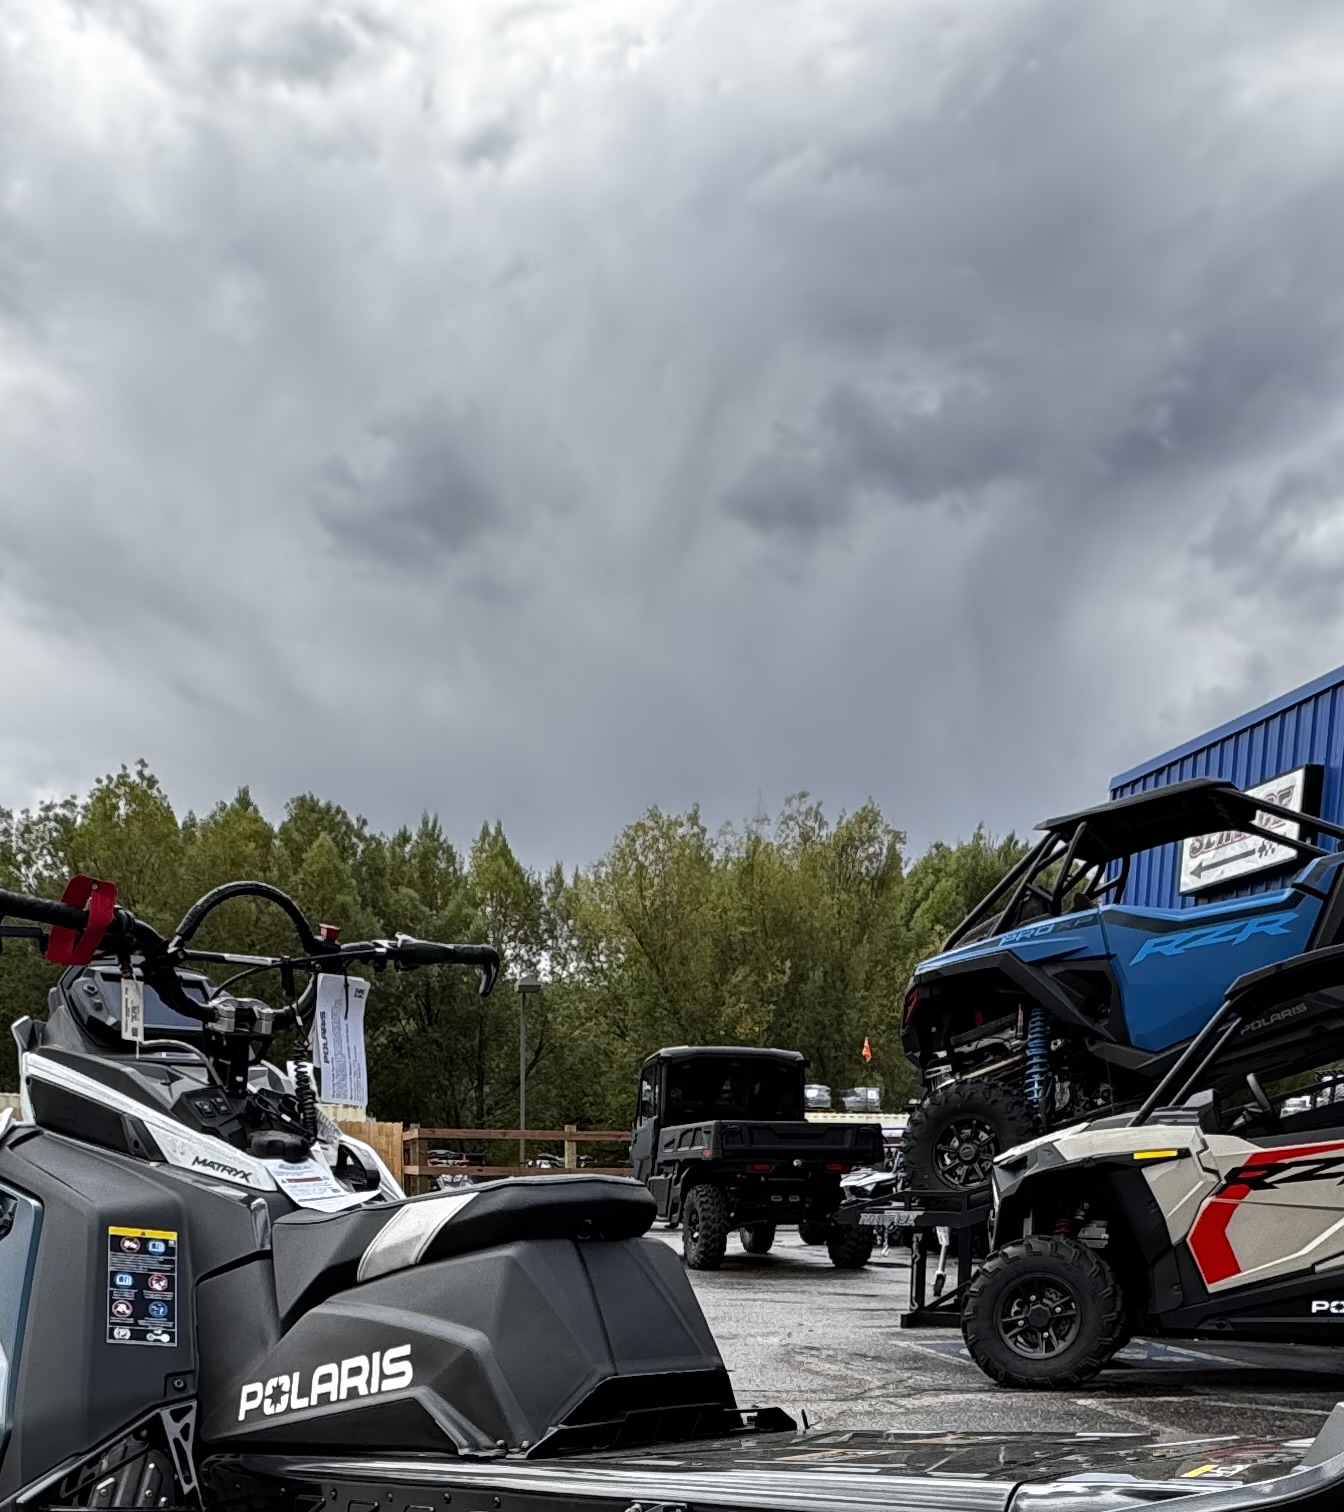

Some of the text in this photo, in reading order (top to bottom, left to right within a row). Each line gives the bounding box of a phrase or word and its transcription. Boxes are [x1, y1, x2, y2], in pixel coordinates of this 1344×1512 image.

[1129, 911, 1298, 967] RZR
[319, 1010, 331, 1064] POLARIS
[1240, 1002, 1308, 1035] POLARIS
[191, 1155, 253, 1184] MATRYX
[238, 1343, 414, 1422] POLARIS
